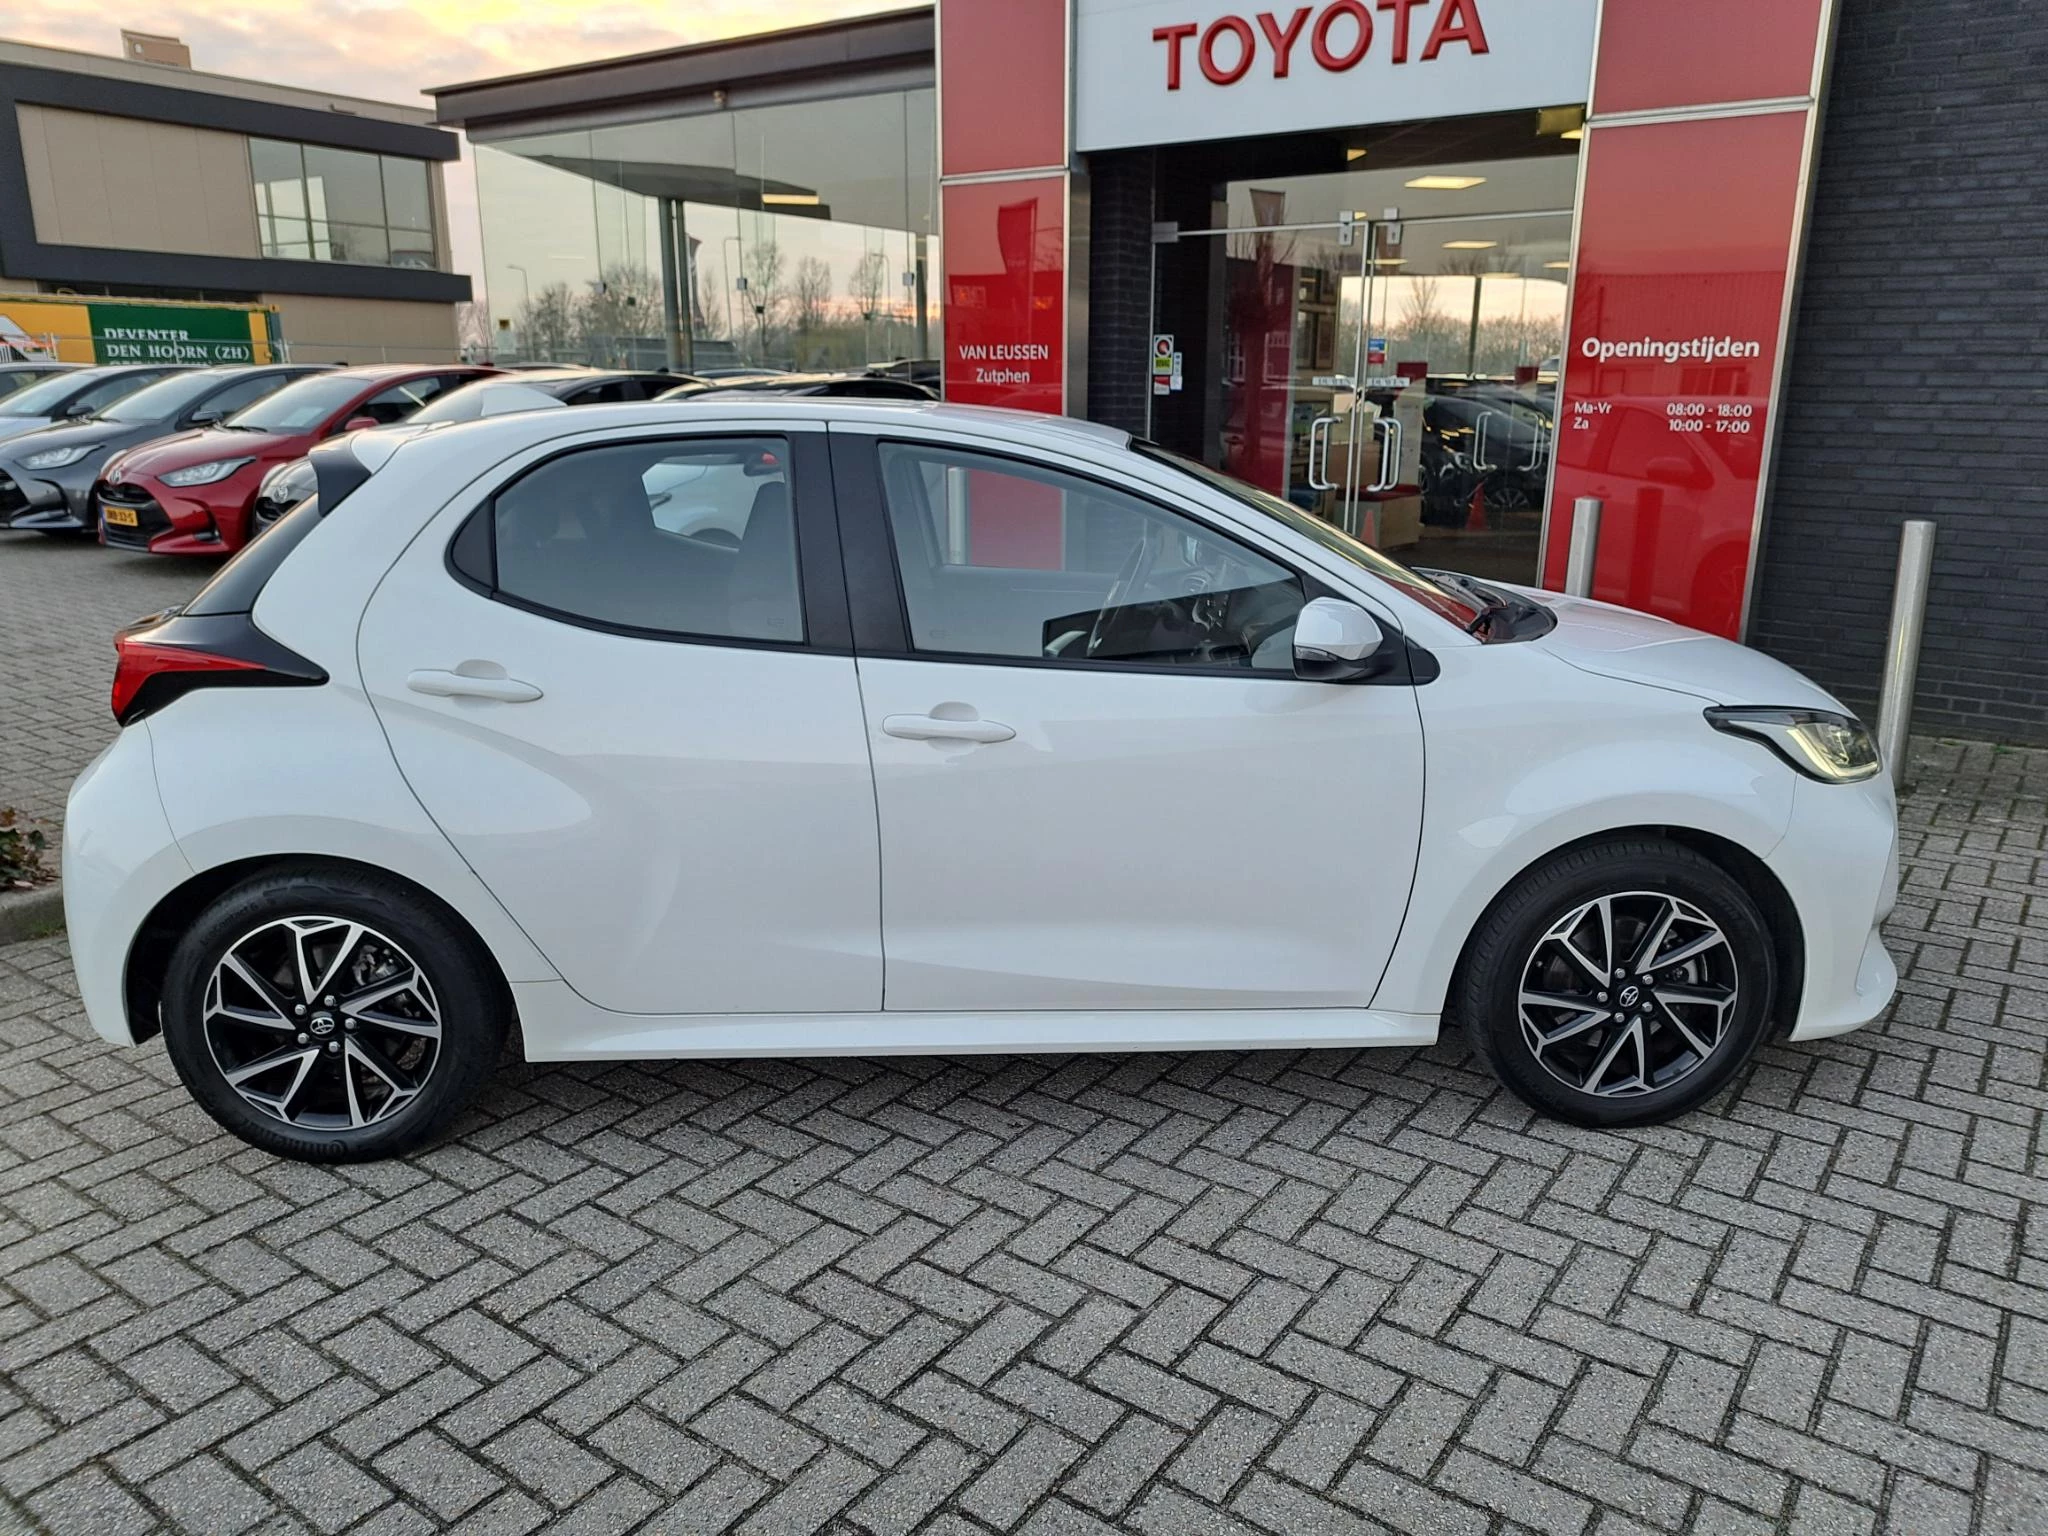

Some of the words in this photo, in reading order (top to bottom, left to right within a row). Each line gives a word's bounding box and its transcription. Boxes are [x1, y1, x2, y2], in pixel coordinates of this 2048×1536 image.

[1152, 0, 1490, 91] TOYOTA
[104, 328, 189, 341] DEVENTER
[106, 344, 142, 358] DEN
[149, 345, 208, 360] HOORN
[215, 346, 250, 361] (ZH)
[959, 344, 987, 360] VAN
[989, 344, 1049, 361] LEUSSEN
[1581, 336, 1760, 363] Openingstijden
[976, 367, 1031, 386] Zutphen
[1574, 402, 1612, 414] Ma-Vr
[1666, 403, 1705, 416] 08:00
[1717, 403, 1752, 417] 18:00
[1573, 417, 1589, 430] Za
[1669, 419, 1703, 432] 10:00
[1715, 419, 1750, 433] 17:00
